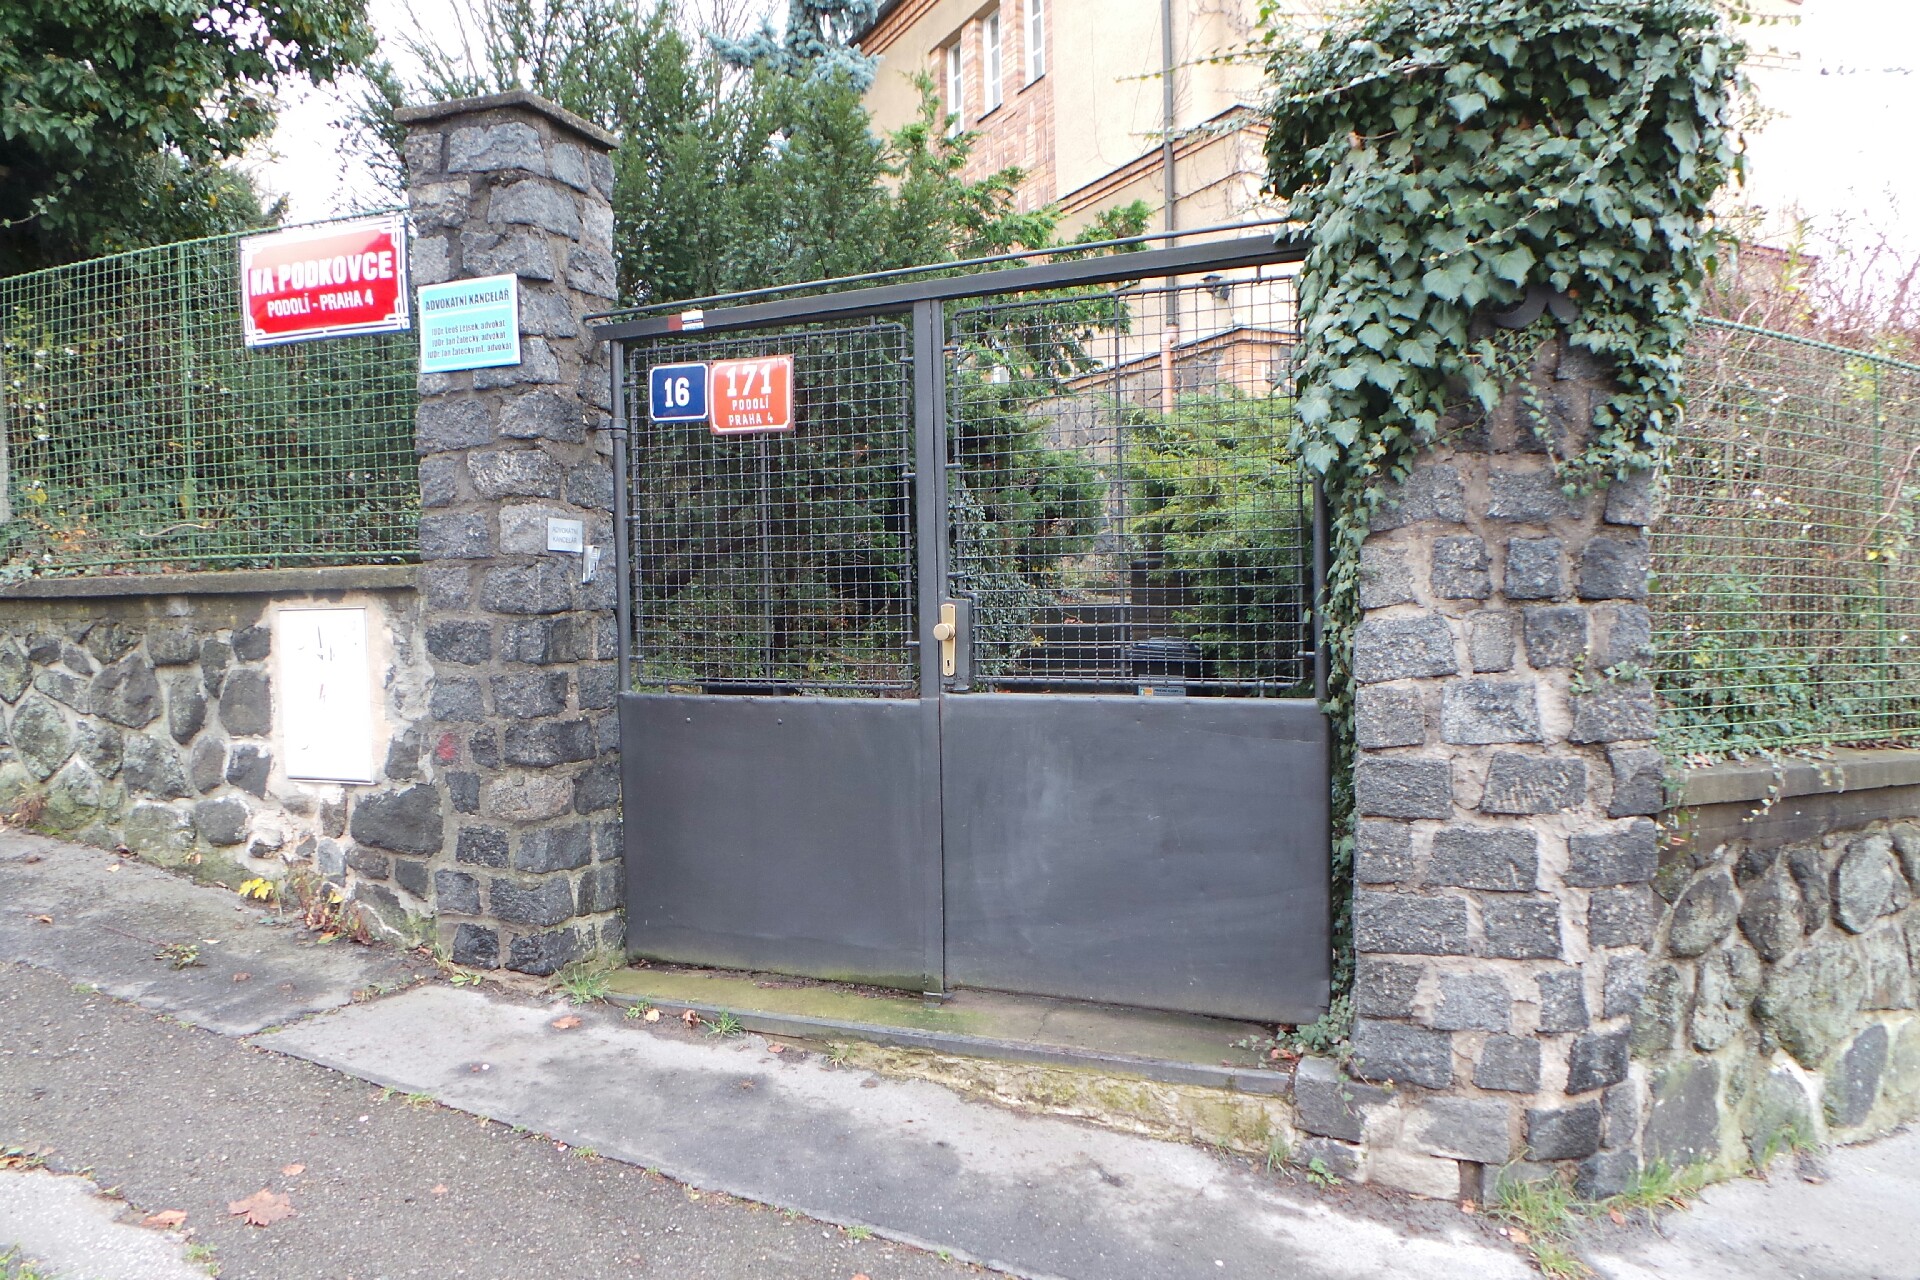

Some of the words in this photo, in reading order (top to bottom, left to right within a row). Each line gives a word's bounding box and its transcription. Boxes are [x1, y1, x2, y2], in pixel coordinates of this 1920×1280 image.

[250, 267, 275, 296] NA
[278, 251, 393, 292] PODKOVCE
[267, 293, 310, 317] PODOLÍ
[319, 291, 363, 311] PRAHA
[364, 288, 374, 306] 4
[425, 294, 467, 311] ADVOKÁTNÍ
[468, 288, 509, 305] KANCELÁŘ
[664, 377, 690, 407] 16
[727, 364, 772, 396] 171
[732, 394, 769, 411] PODOLÍ
[728, 413, 762, 426] PRAHA
[767, 412, 774, 424] 4
